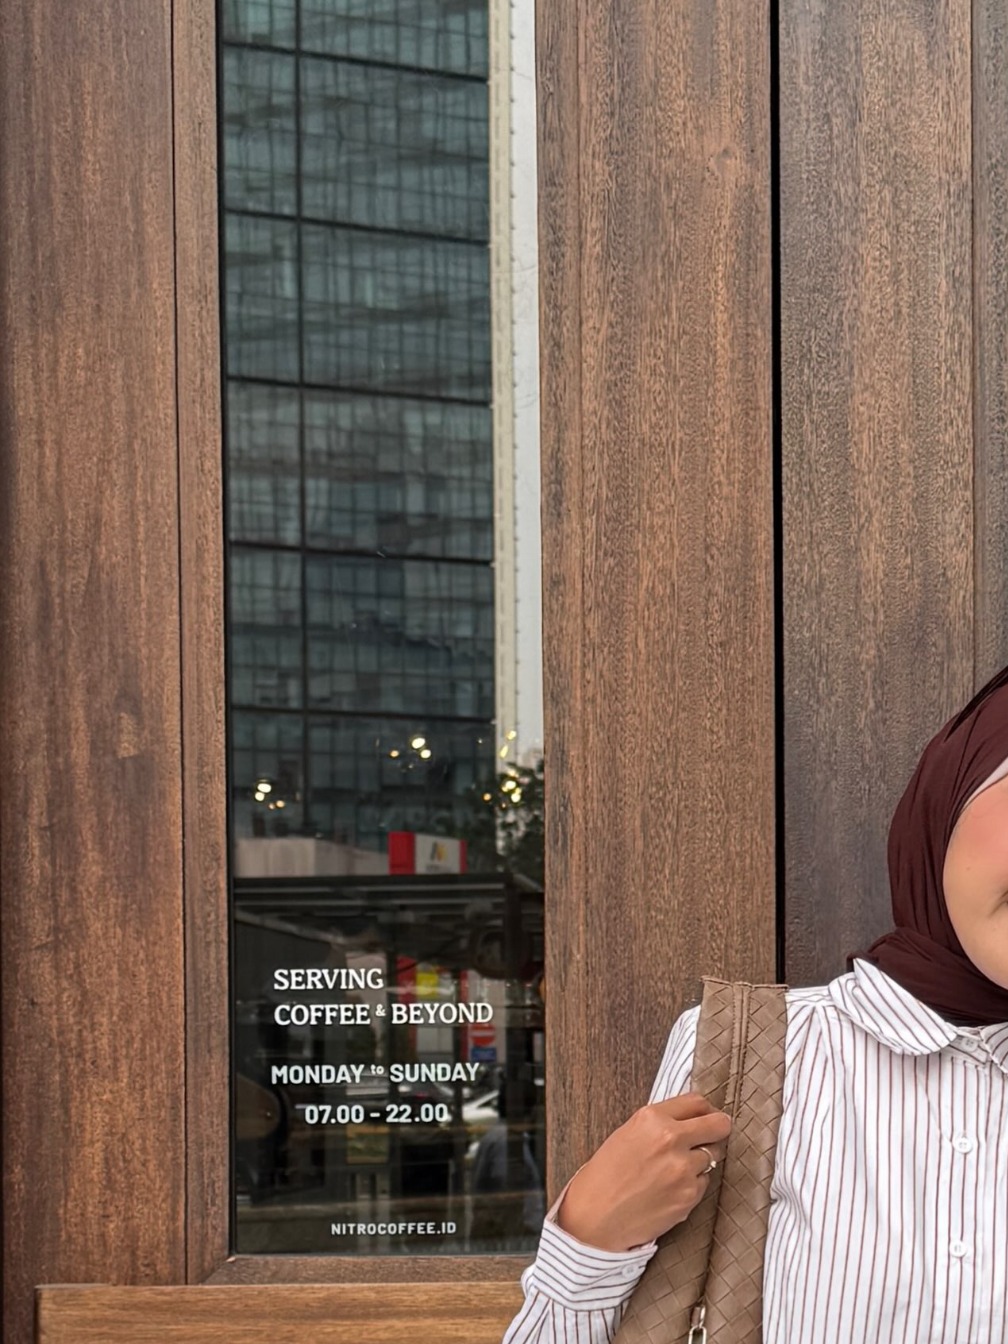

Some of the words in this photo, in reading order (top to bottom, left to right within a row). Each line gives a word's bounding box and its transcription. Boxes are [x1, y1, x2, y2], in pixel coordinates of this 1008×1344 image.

[273, 968, 384, 990] SERVING
[274, 1004, 371, 1025] COFFEE
[375, 1004, 386, 1016] &
[392, 1002, 493, 1024] BEYOND
[271, 1064, 364, 1084] MONDAY
[371, 1064, 384, 1075] to
[390, 1063, 479, 1082] SUNDAY
[305, 1105, 364, 1124] 07.00
[386, 1103, 448, 1122] 22.00
[331, 1222, 456, 1235] NITROCOFFEE.ID
